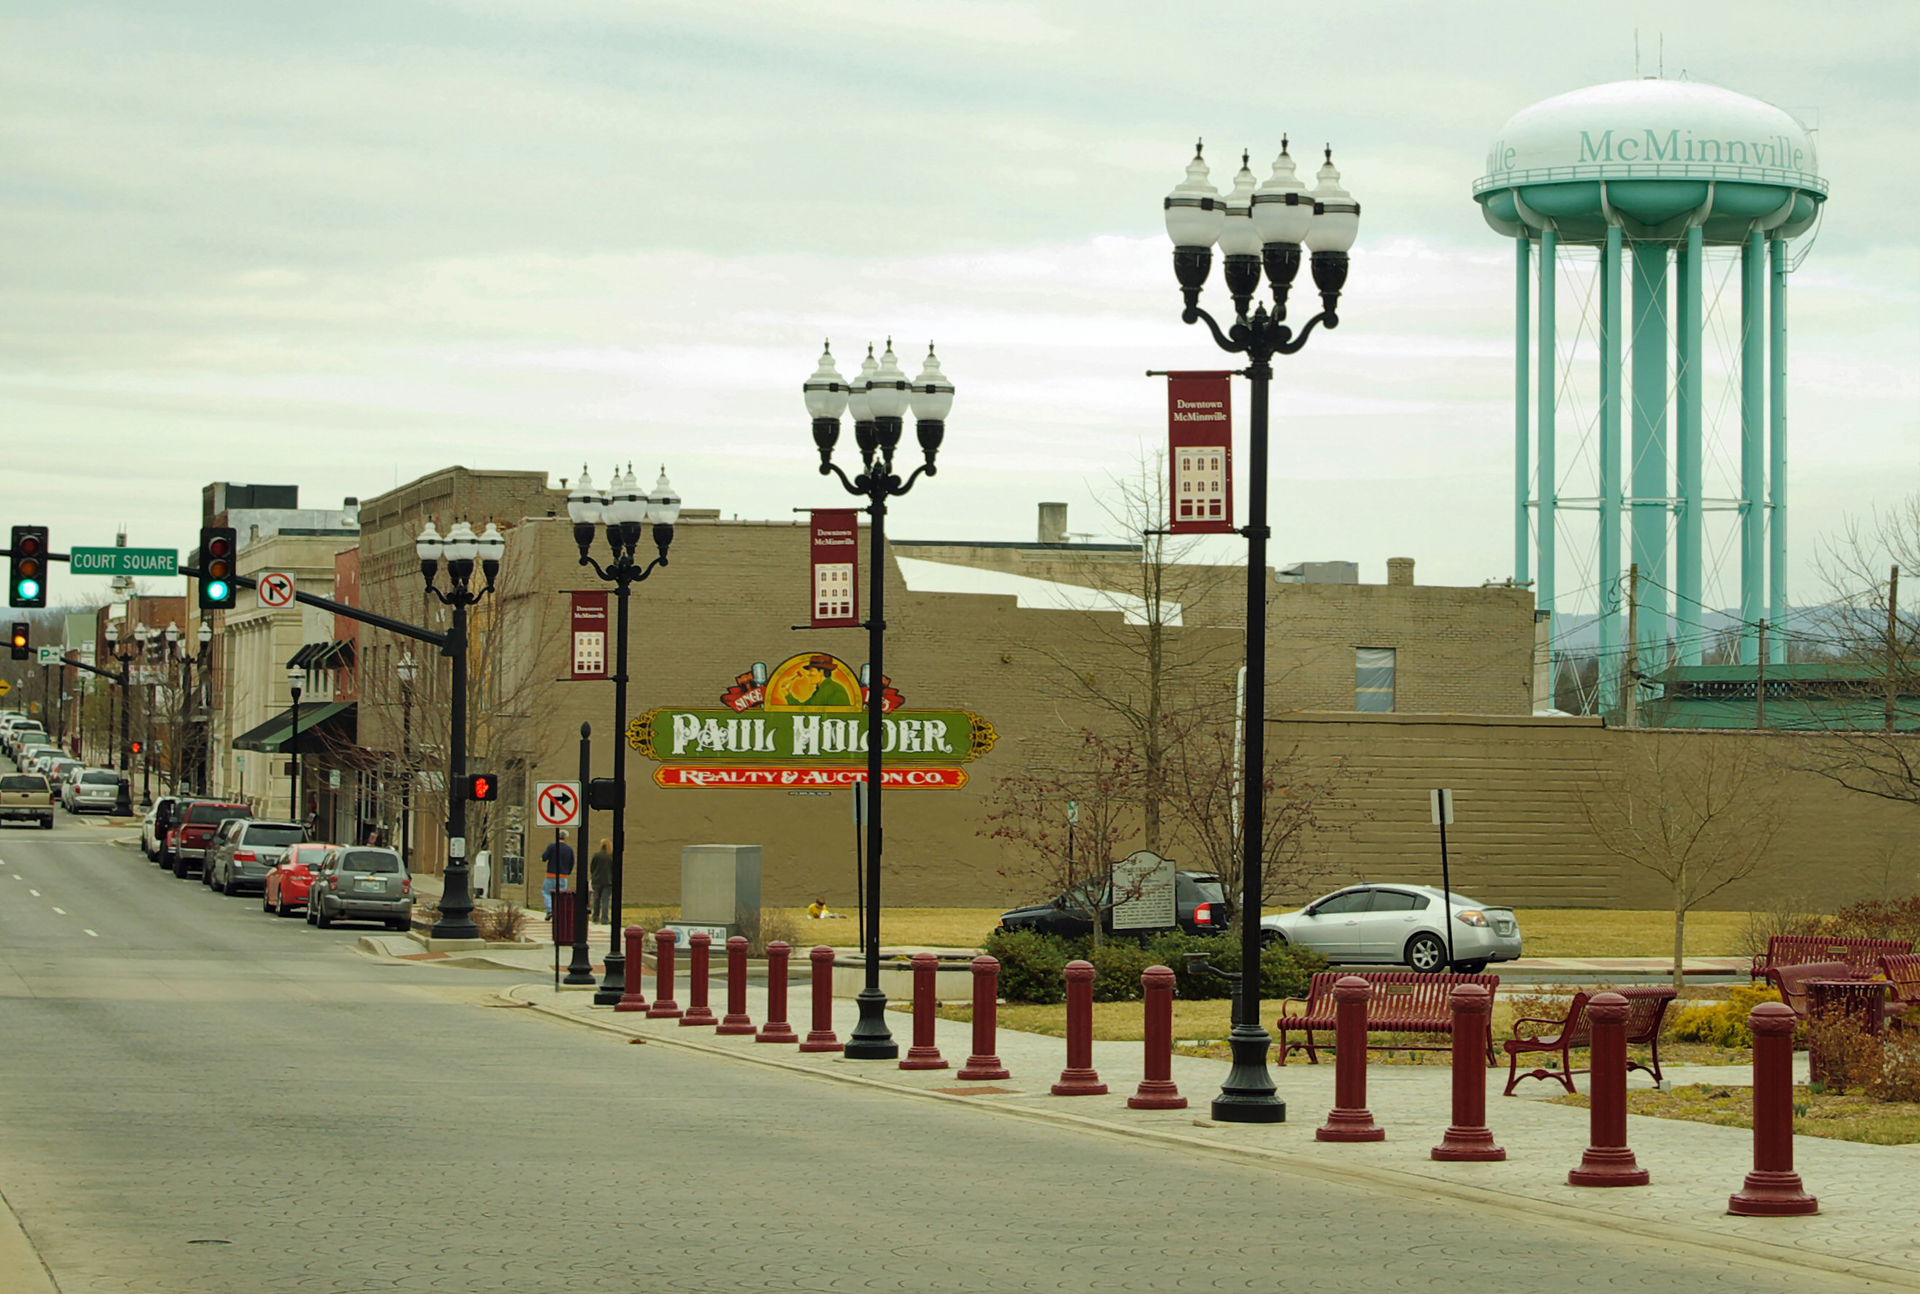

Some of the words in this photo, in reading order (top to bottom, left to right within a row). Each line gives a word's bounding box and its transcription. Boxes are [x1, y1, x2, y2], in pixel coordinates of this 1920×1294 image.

[1577, 128, 1804, 170] McMinnville
[1177, 400, 1222, 408] Downtown
[1174, 412, 1227, 421] McMinnville
[74, 553, 116, 568] COURT
[123, 554, 174, 570] SQUARE
[40, 649, 51, 661] P
[671, 713, 776, 755] PAUL
[679, 770, 778, 786] REALTY
[781, 770, 798, 784] &
[802, 771, 904, 784] AUCTON
